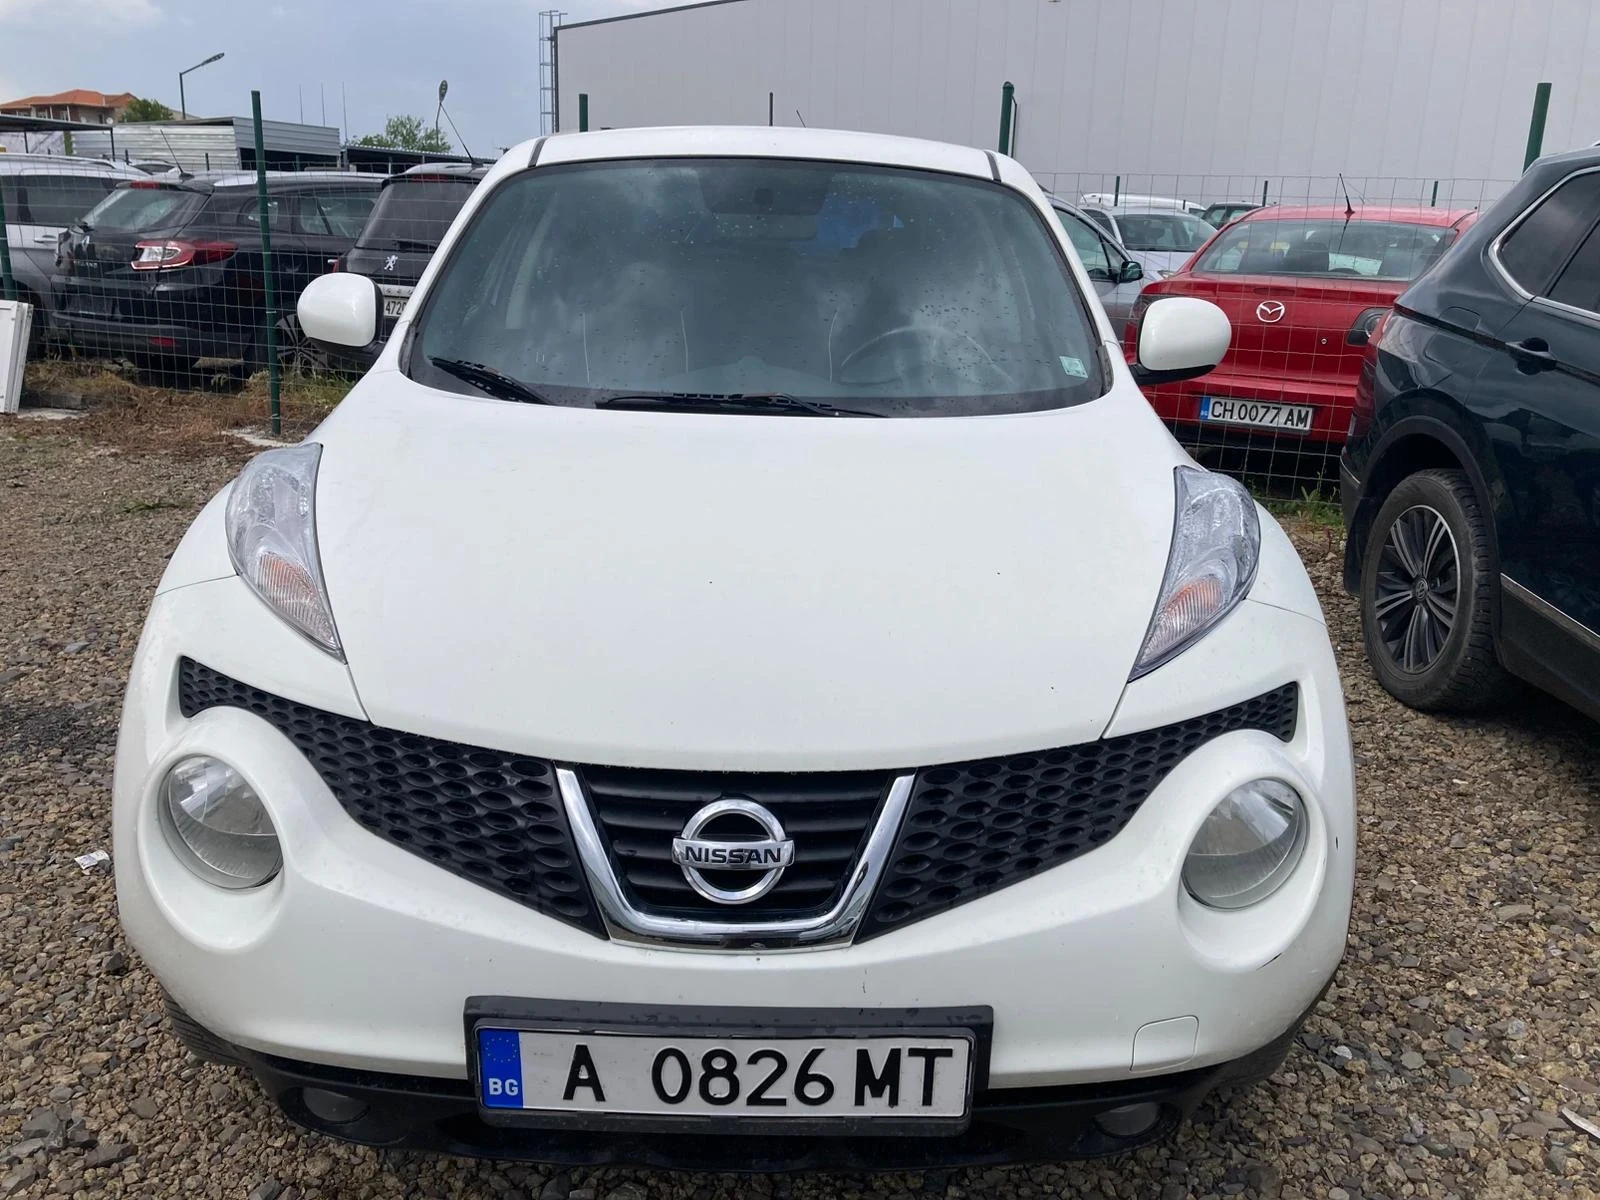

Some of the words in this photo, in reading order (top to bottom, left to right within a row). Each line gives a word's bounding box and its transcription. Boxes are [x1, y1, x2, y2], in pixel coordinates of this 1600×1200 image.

[1211, 400, 1235, 420] CH
[1238, 403, 1282, 424] 0077
[1284, 408, 1310, 428] AM
[685, 846, 781, 864] NISSAN
[488, 1077, 519, 1096] BG
[562, 1044, 606, 1102] A
[651, 1047, 835, 1107] 0826
[854, 1047, 953, 1108] MT
